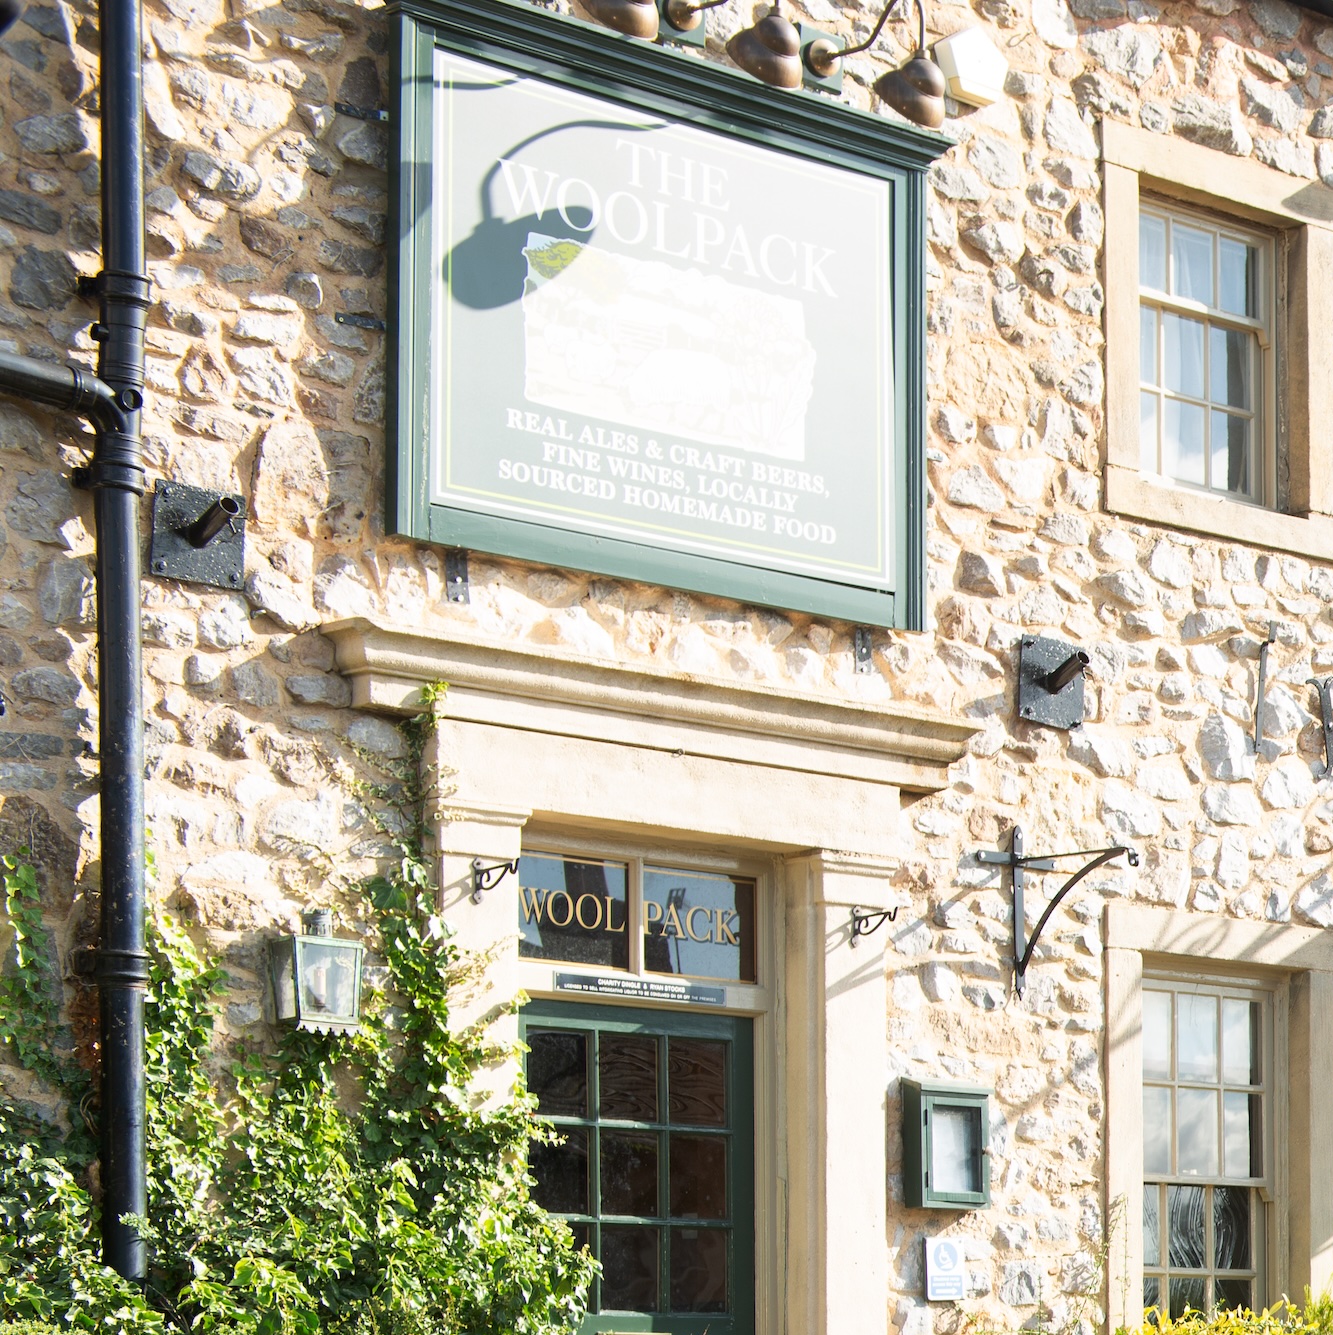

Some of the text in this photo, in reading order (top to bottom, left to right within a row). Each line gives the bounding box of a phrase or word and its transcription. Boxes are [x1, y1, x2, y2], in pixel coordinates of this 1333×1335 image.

[614, 137, 731, 212] THE
[496, 157, 838, 299] WOOLPACK
[505, 407, 831, 499] REAL ALES & CRAFT BEERS,
[541, 441, 798, 513] FINE WINES, LOCALLY
[498, 459, 837, 545] SOURCED HOMEMADE FOOD
[597, 978, 621, 987] CHARITY
[650, 984, 664, 992] RYAN
